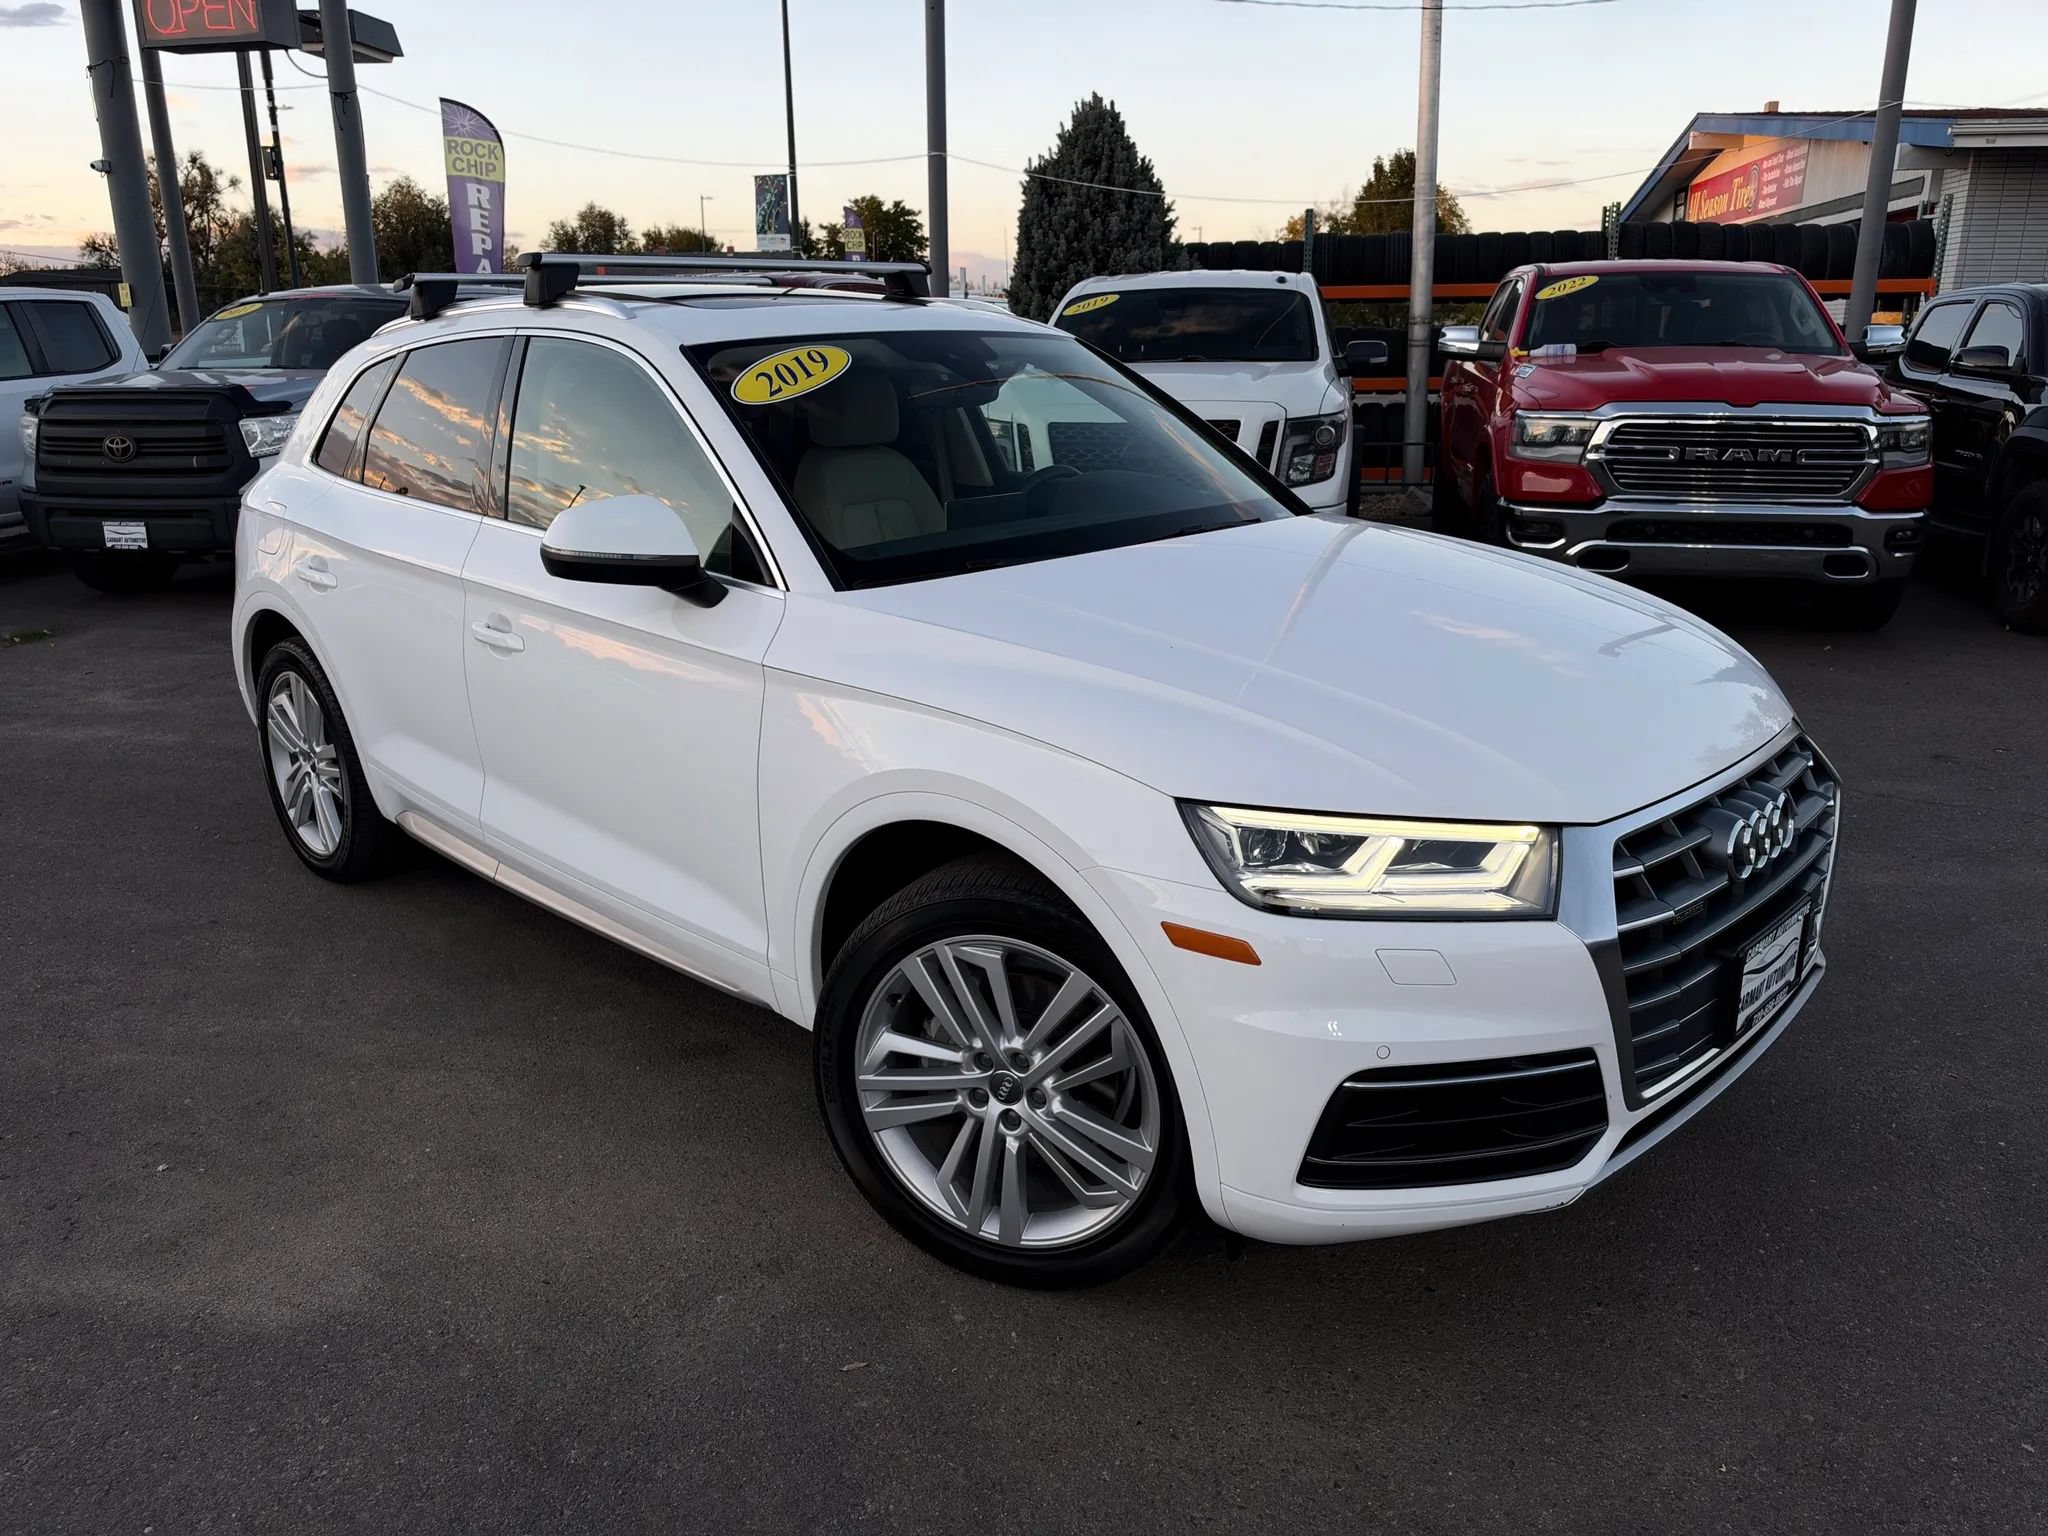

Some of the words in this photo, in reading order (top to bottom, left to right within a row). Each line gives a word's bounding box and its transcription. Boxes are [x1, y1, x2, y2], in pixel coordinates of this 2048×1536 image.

[147, 0, 257, 33] OPEN
[447, 138, 499, 161] ROCK
[452, 157, 497, 177] CHIP
[1699, 189, 1729, 220] Season
[1547, 277, 1587, 298] 2022
[1071, 296, 1109, 313] 2019
[755, 349, 829, 398] 2019
[1684, 446, 1793, 463] RAM
[1746, 929, 1777, 962] CARMART
